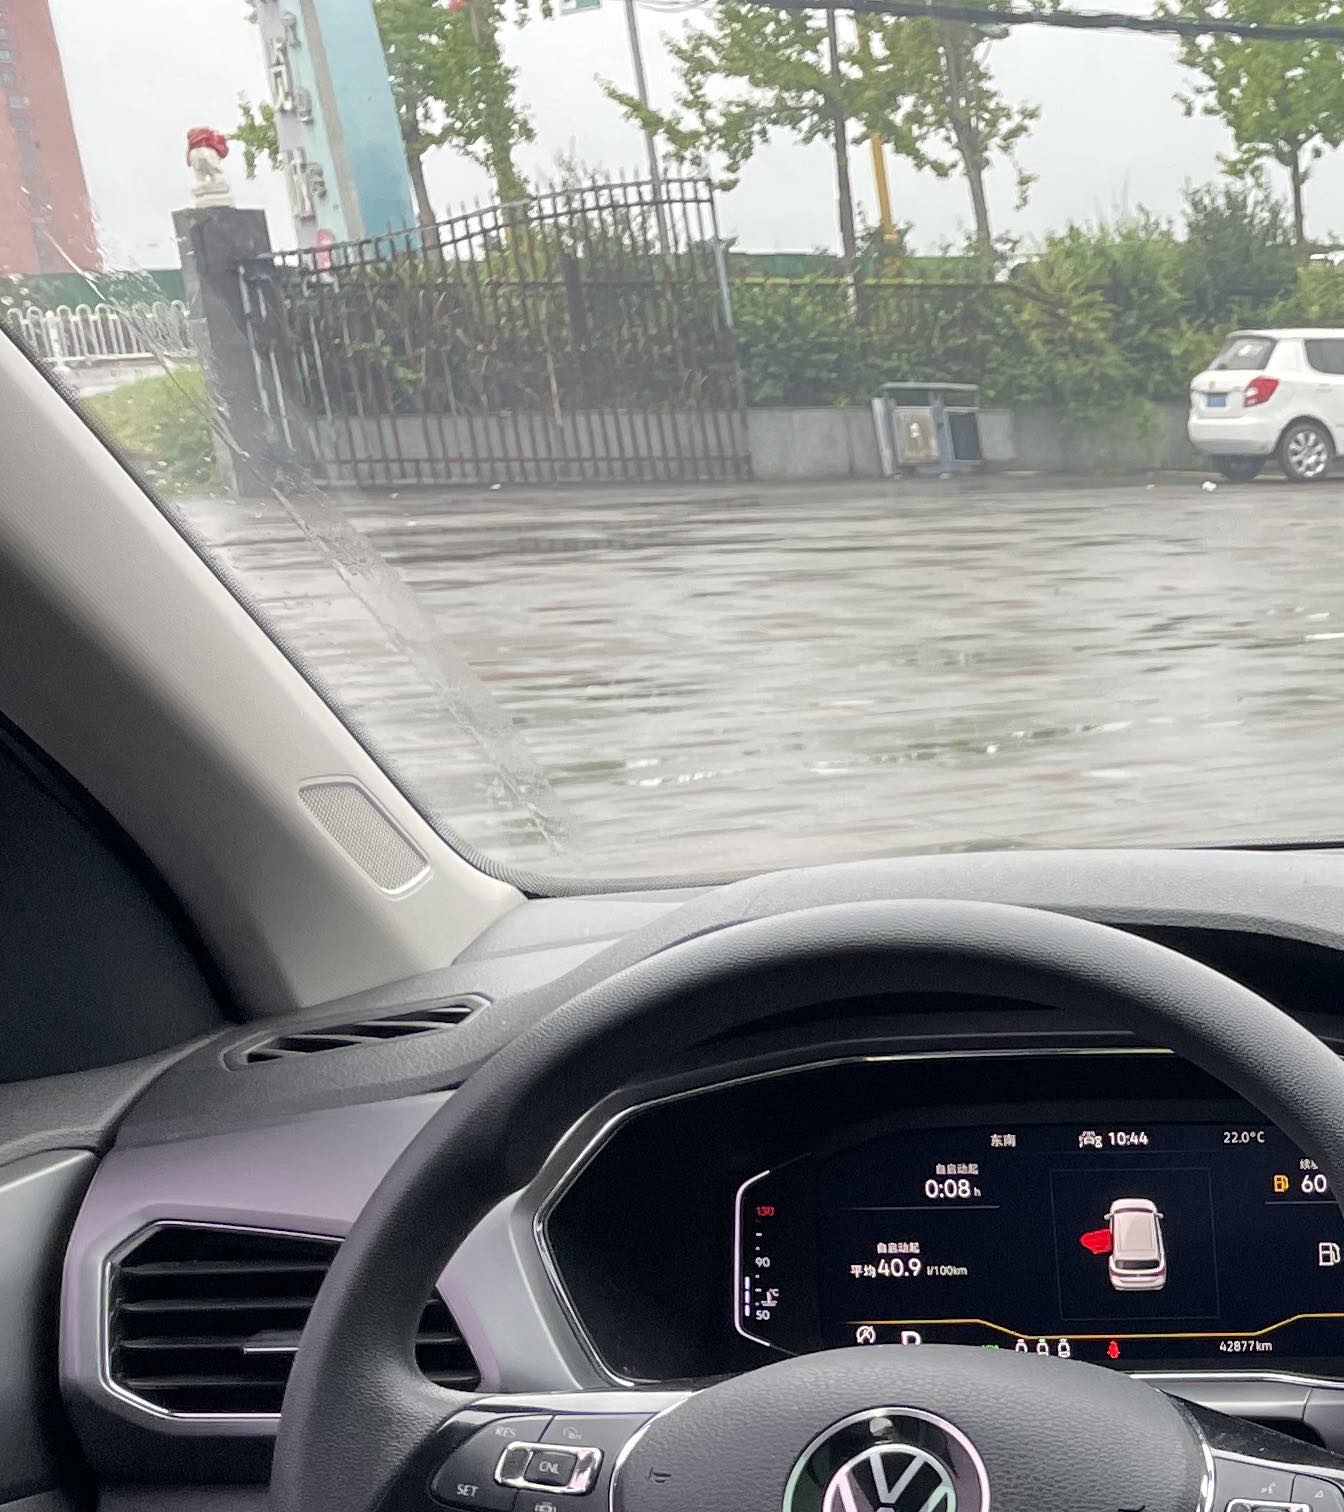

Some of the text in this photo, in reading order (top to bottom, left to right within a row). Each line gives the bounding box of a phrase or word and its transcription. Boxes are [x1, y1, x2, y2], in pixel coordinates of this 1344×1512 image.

[990, 1133, 1017, 1148] 东南
[1108, 1131, 1148, 1146] 10:44
[1223, 1130, 1265, 1144] 22.0°C
[935, 1163, 979, 1175] 自启动起
[924, 1178, 971, 1198] 0:08
[1301, 1174, 1327, 1193] 60
[755, 1257, 771, 1268] 90
[755, 1310, 771, 1321] 50
[495, 1426, 516, 1438] RES
[539, 1461, 560, 1475] CNL
[457, 1484, 479, 1498] SET
